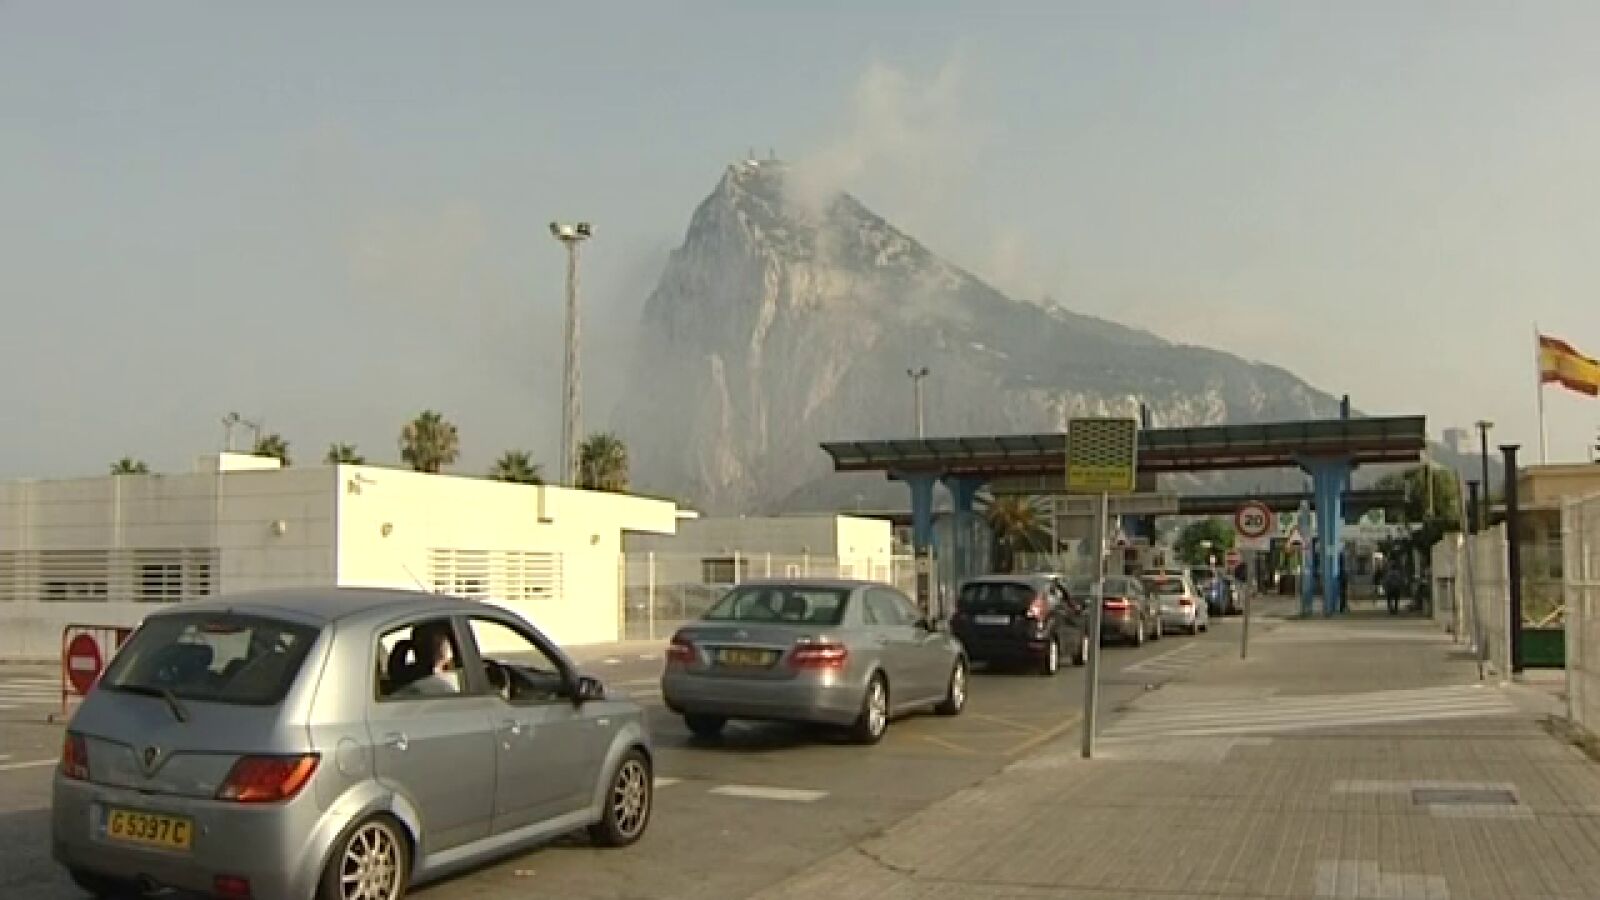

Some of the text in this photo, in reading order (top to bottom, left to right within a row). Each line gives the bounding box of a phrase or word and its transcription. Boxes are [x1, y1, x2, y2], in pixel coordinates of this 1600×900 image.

[1244, 514, 1264, 526] 20
[112, 813, 187, 844] G 5397 C
